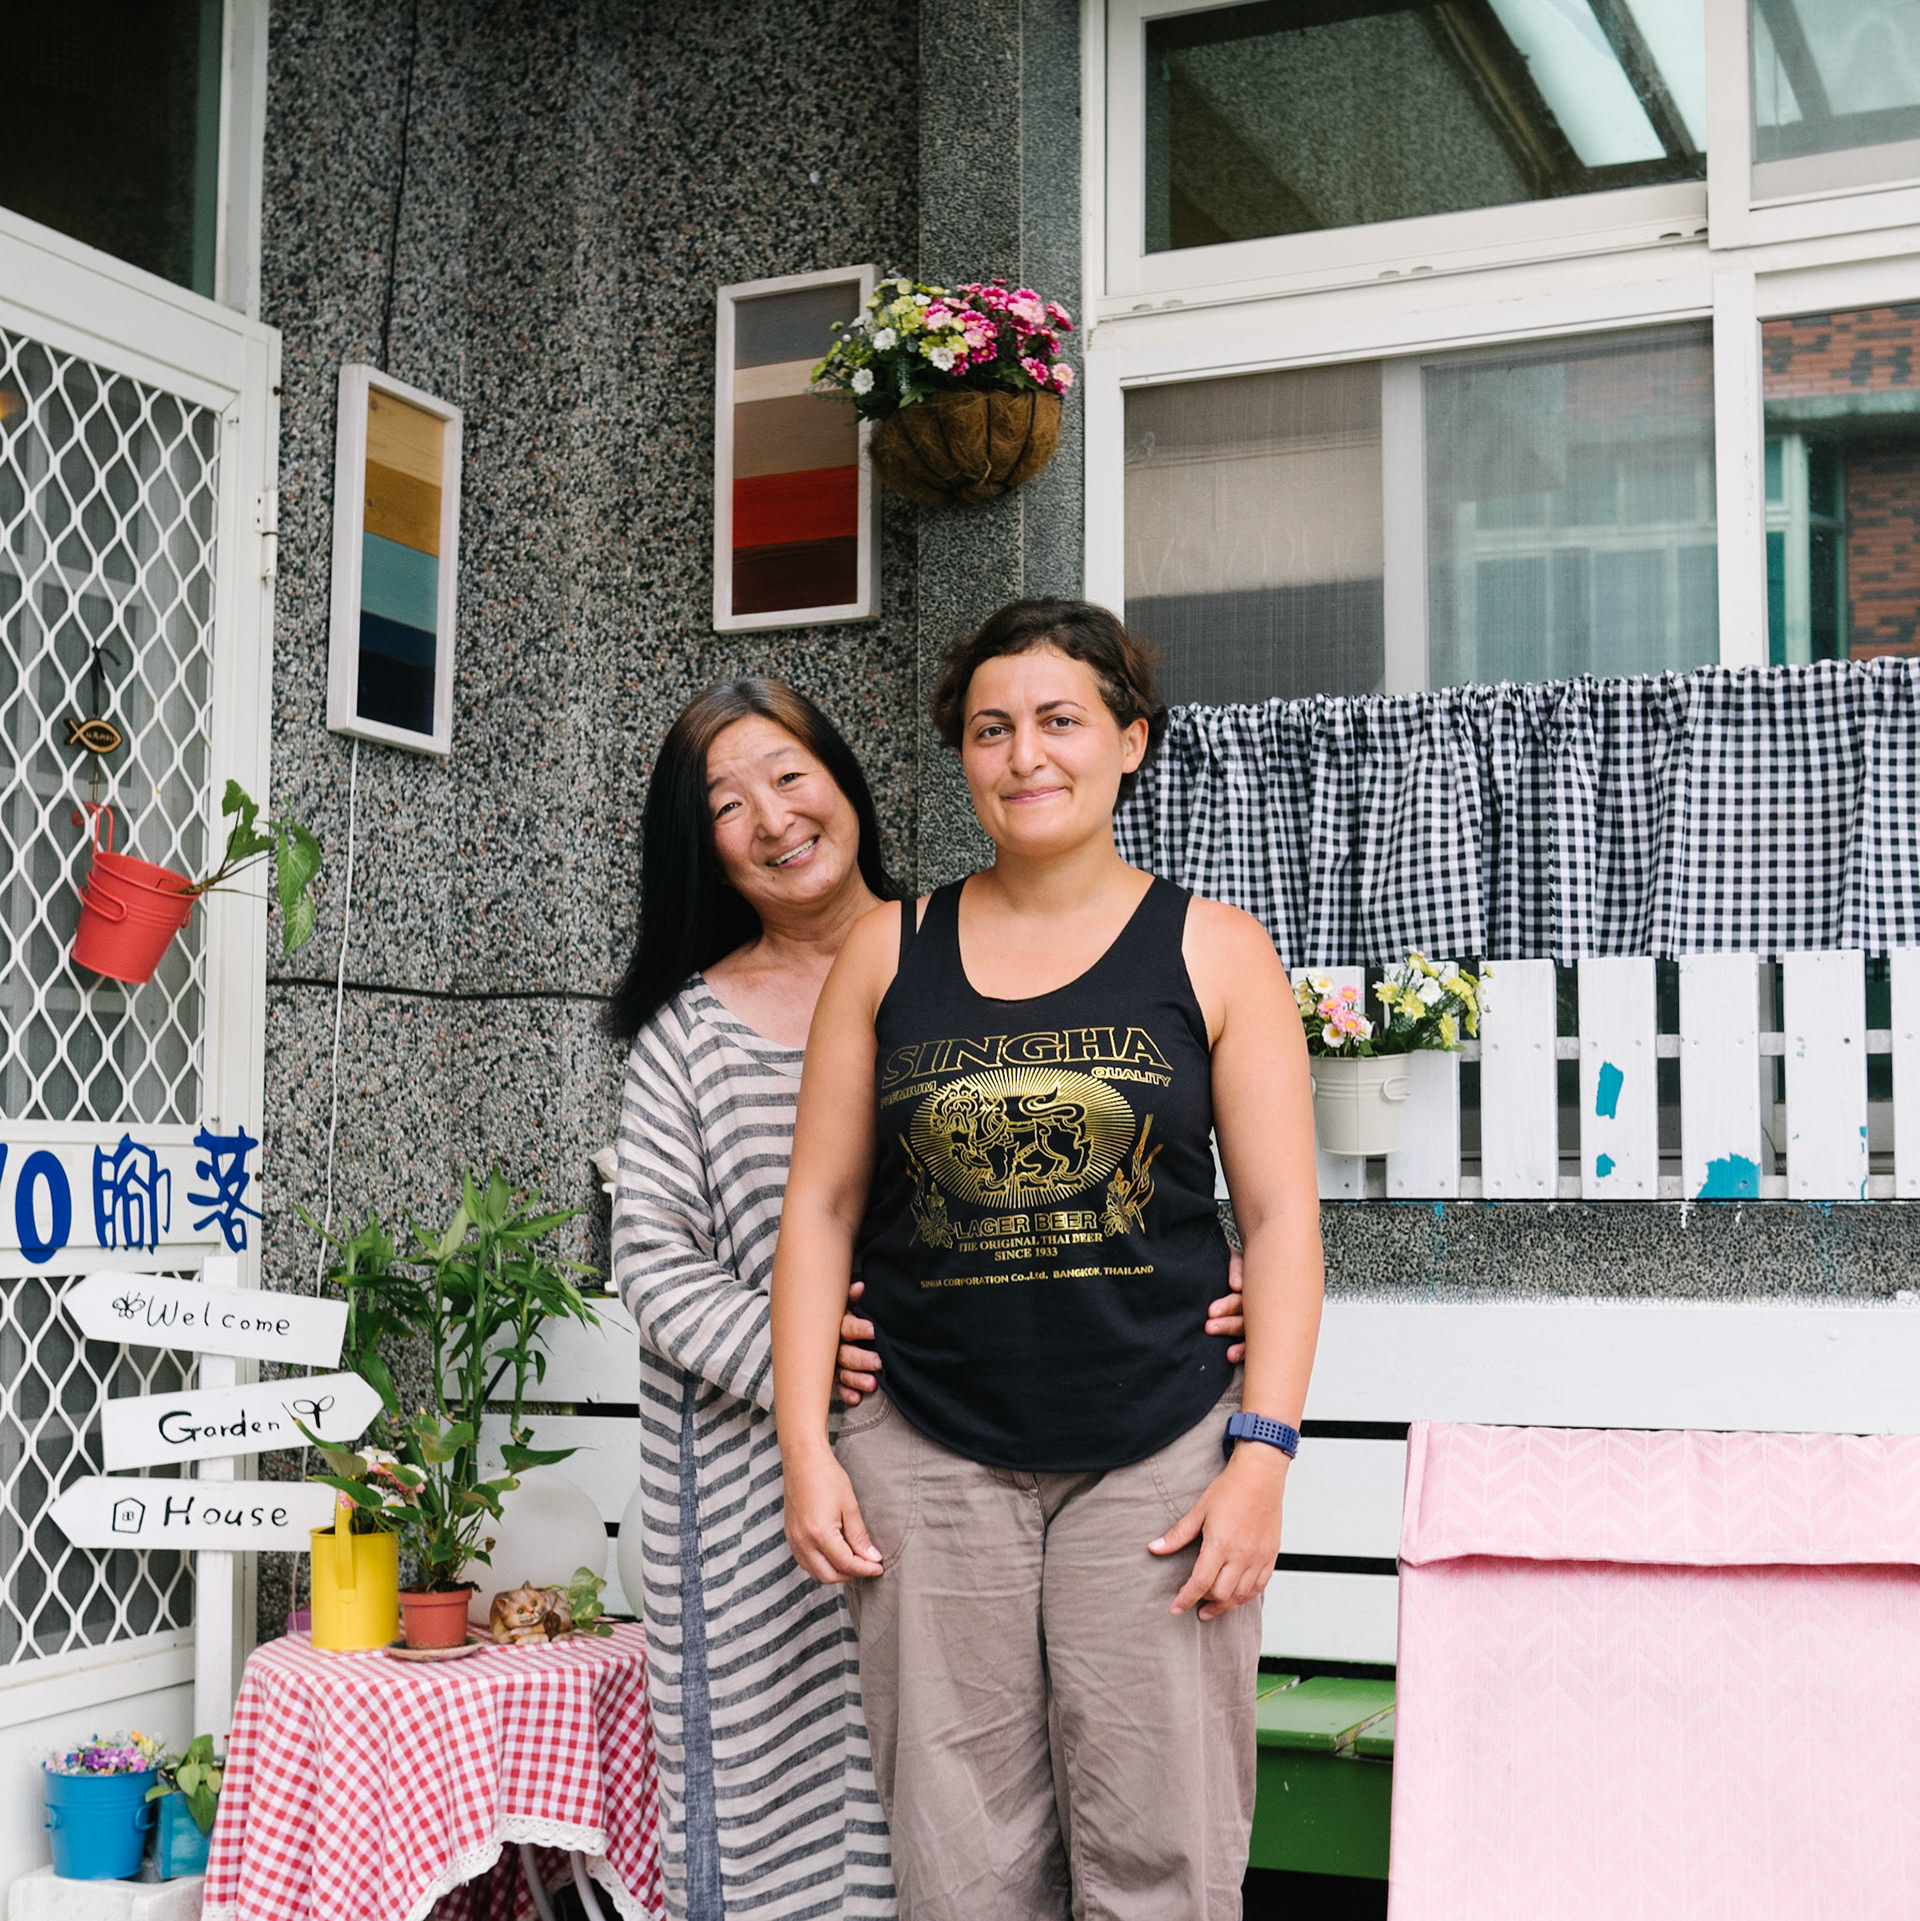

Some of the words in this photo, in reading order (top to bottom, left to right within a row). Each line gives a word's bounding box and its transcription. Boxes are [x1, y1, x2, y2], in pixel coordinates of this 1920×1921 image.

[881, 1026, 1174, 1089] SINGHA
[880, 1080, 938, 1109] PREMIUM
[1091, 1066, 1172, 1087] QUALITY
[954, 1213, 1031, 1240] LAGER
[1034, 1210, 1098, 1232] BEER
[958, 1241, 978, 1253] THE
[979, 1235, 1040, 1251] ORIGINAL
[1040, 1233, 1071, 1246] THAI
[1071, 1231, 1103, 1243] BEER
[994, 1248, 1033, 1262] SINCE
[1035, 1246, 1059, 1258] 1933
[943, 1274, 1009, 1287] CORPORATION
[1103, 1264, 1155, 1276] THAILAND
[145, 1297, 291, 1337] Welcome
[158, 1409, 281, 1445] Garden
[163, 1496, 289, 1528] House
